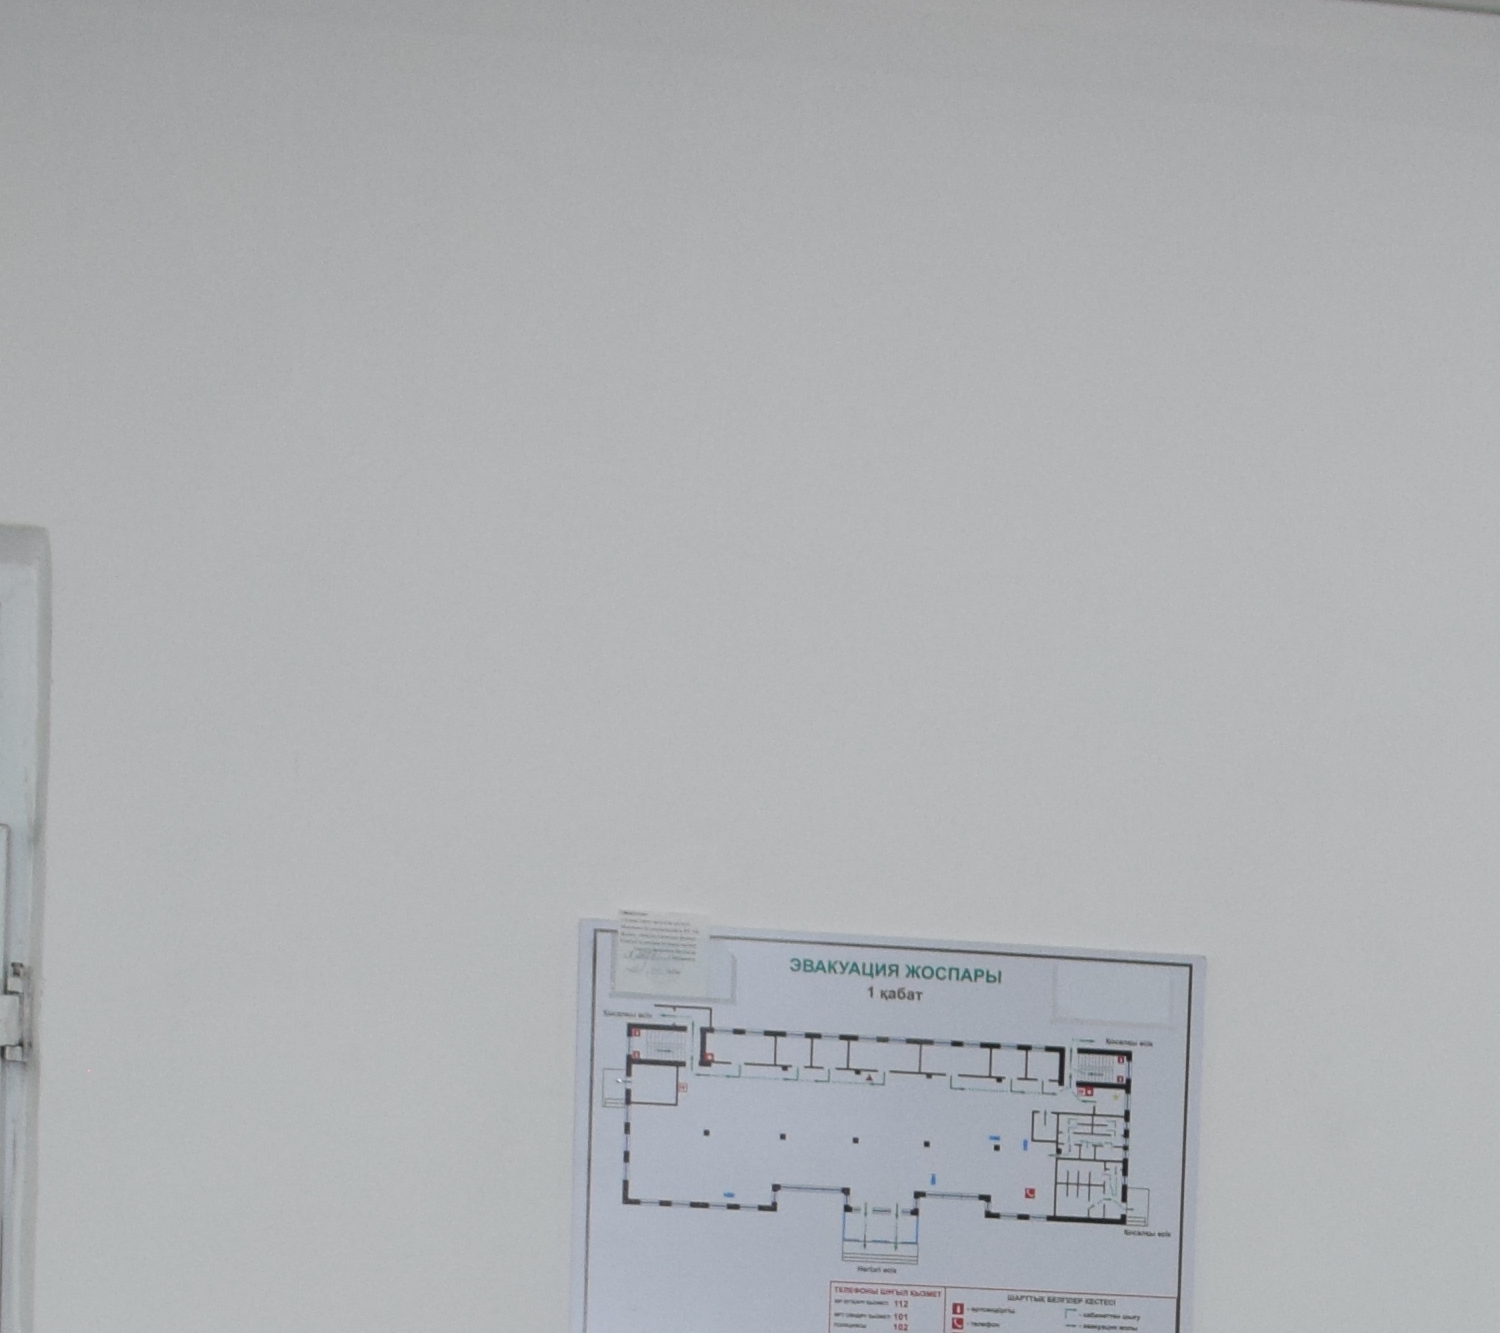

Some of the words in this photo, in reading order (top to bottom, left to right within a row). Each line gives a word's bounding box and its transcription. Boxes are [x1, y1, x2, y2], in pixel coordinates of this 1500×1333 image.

[789, 957, 900, 979] ЭВАКУАЦИЯ
[905, 964, 1003, 984] ЖОСПАРЫ
[867, 985, 874, 998] 1
[880, 986, 924, 1001] қабат
[894, 1300, 908, 1308] 112
[894, 1313, 908, 1321] 101
[893, 1323, 908, 1331] 102
